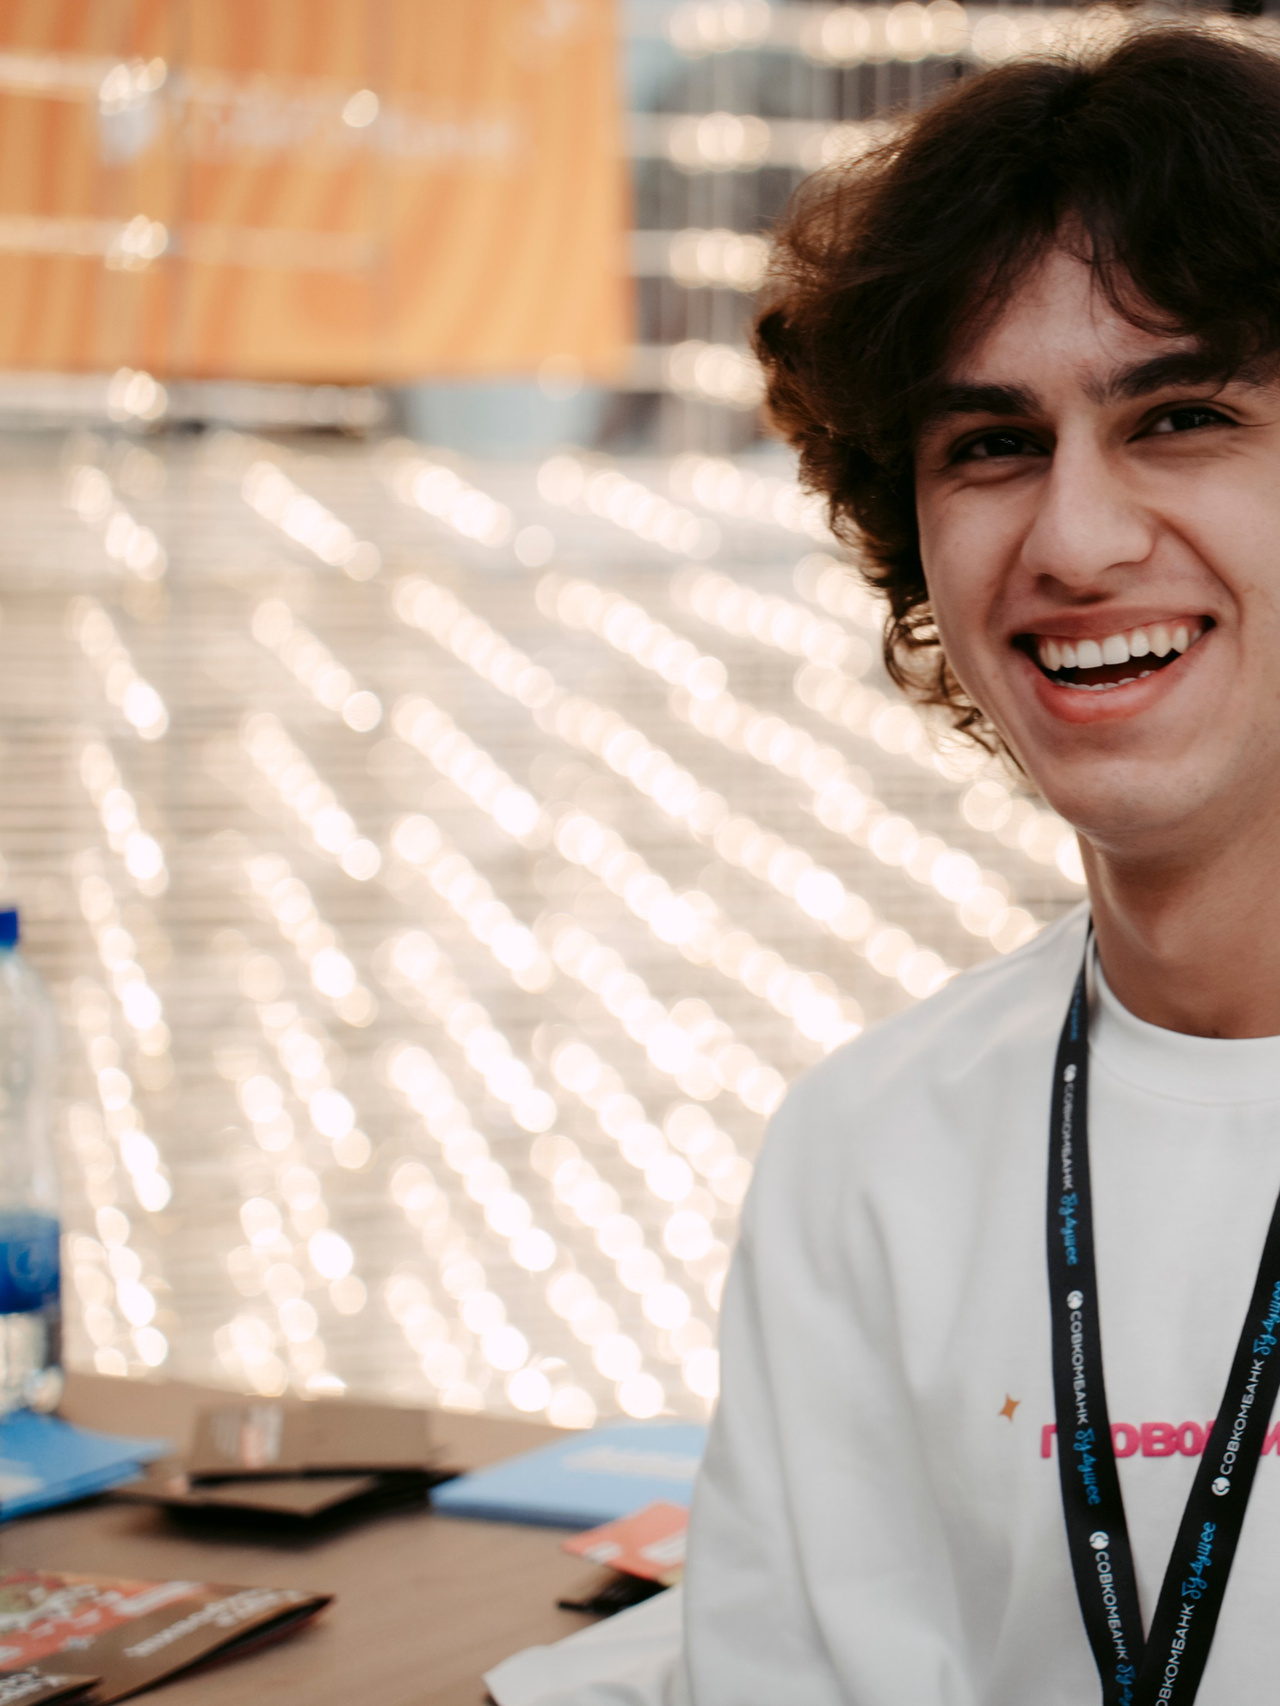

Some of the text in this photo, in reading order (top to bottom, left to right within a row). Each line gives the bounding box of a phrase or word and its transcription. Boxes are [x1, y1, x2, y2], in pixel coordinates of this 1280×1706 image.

[1070, 1310, 1088, 1425] СОВКОМБАНК
[1220, 1359, 1265, 1475] СОВКОМБАНК
[1095, 1551, 1129, 1660] СОВКОМБАНК
